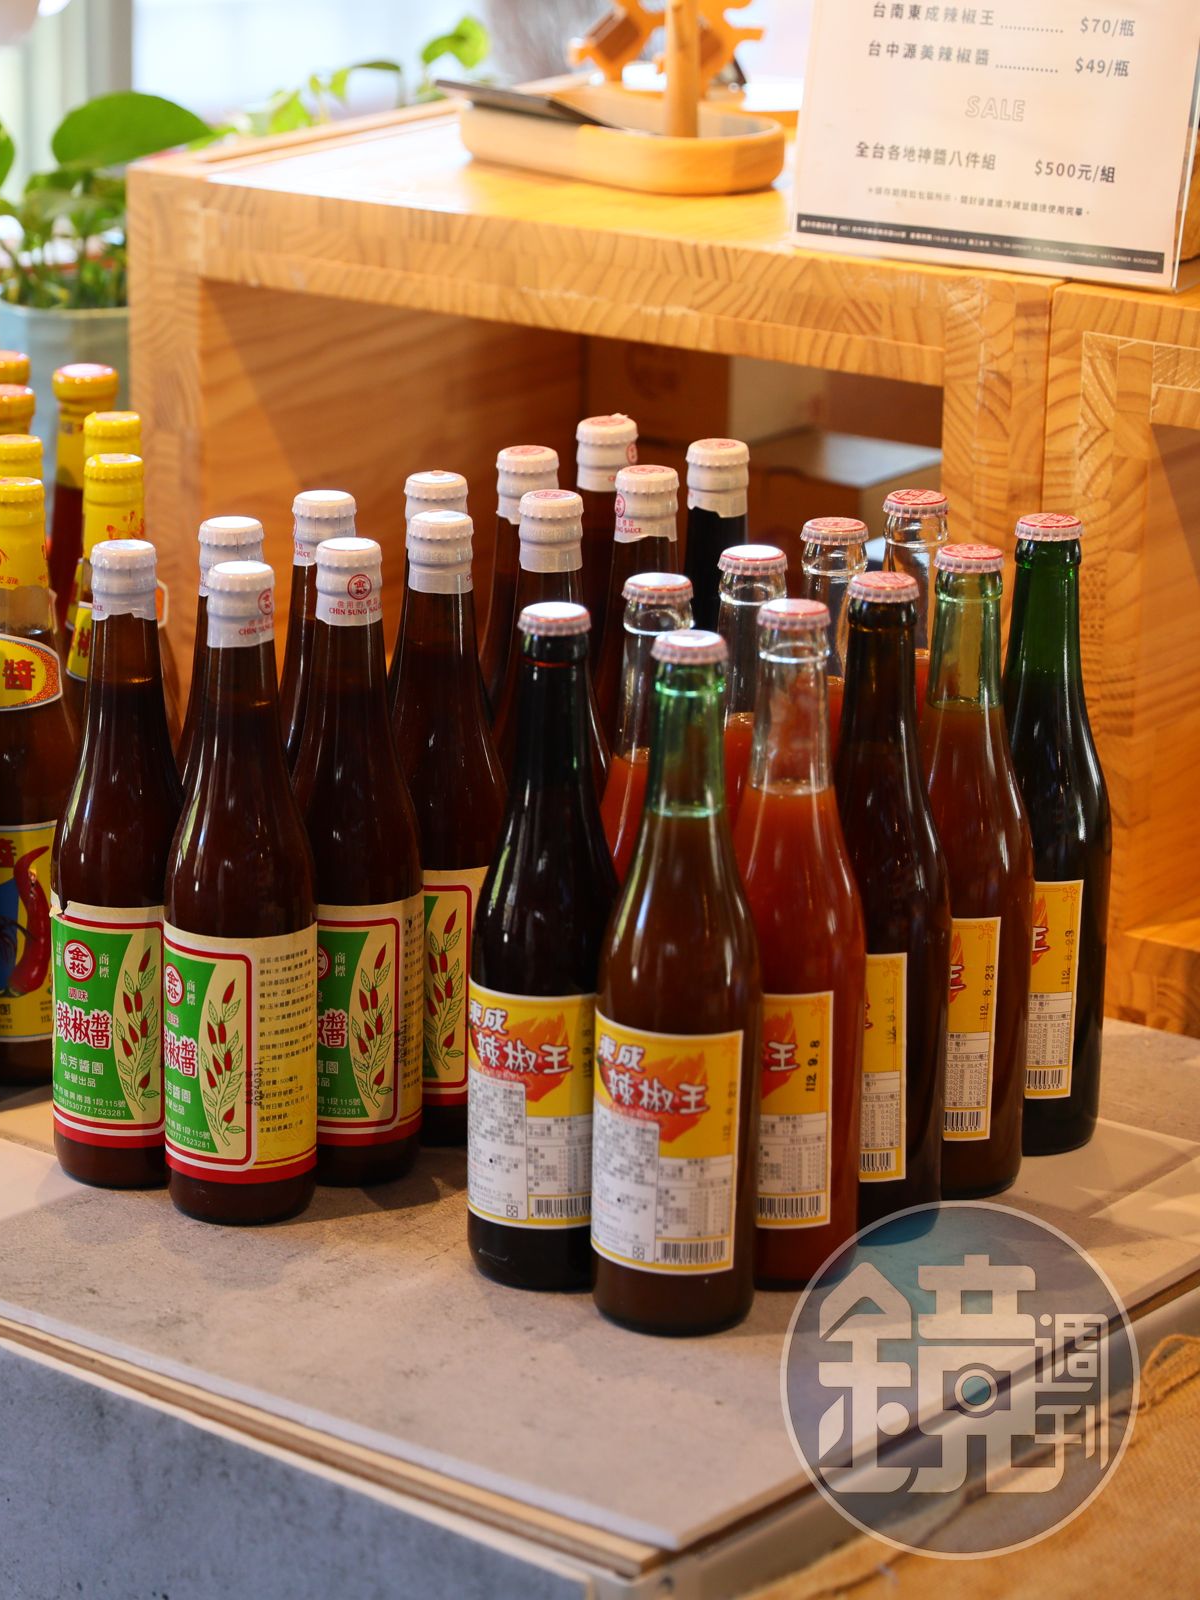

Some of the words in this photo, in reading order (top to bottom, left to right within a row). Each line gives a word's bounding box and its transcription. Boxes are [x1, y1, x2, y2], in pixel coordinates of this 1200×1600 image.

[872, 1, 995, 26] 台南東成辣椒王
[1079, 16, 1136, 37] $70/瓶
[1074, 57, 1130, 77] $49/瓶
[965, 95, 1026, 123] SALE
[855, 141, 997, 171] 全台各地神醬八件組
[1034, 159, 1117, 184] $500元/組
[328, 607, 346, 616] CHIN
[347, 607, 368, 616] SUNG
[68, 946, 90, 975] 金松
[56, 999, 113, 1050] 辣椒醬
[469, 1000, 508, 1034] 東成
[477, 1031, 574, 1075] 辣椒王
[598, 1034, 646, 1073] 東成
[767, 1041, 800, 1073] 王
[608, 1068, 711, 1115] 辣椒王
